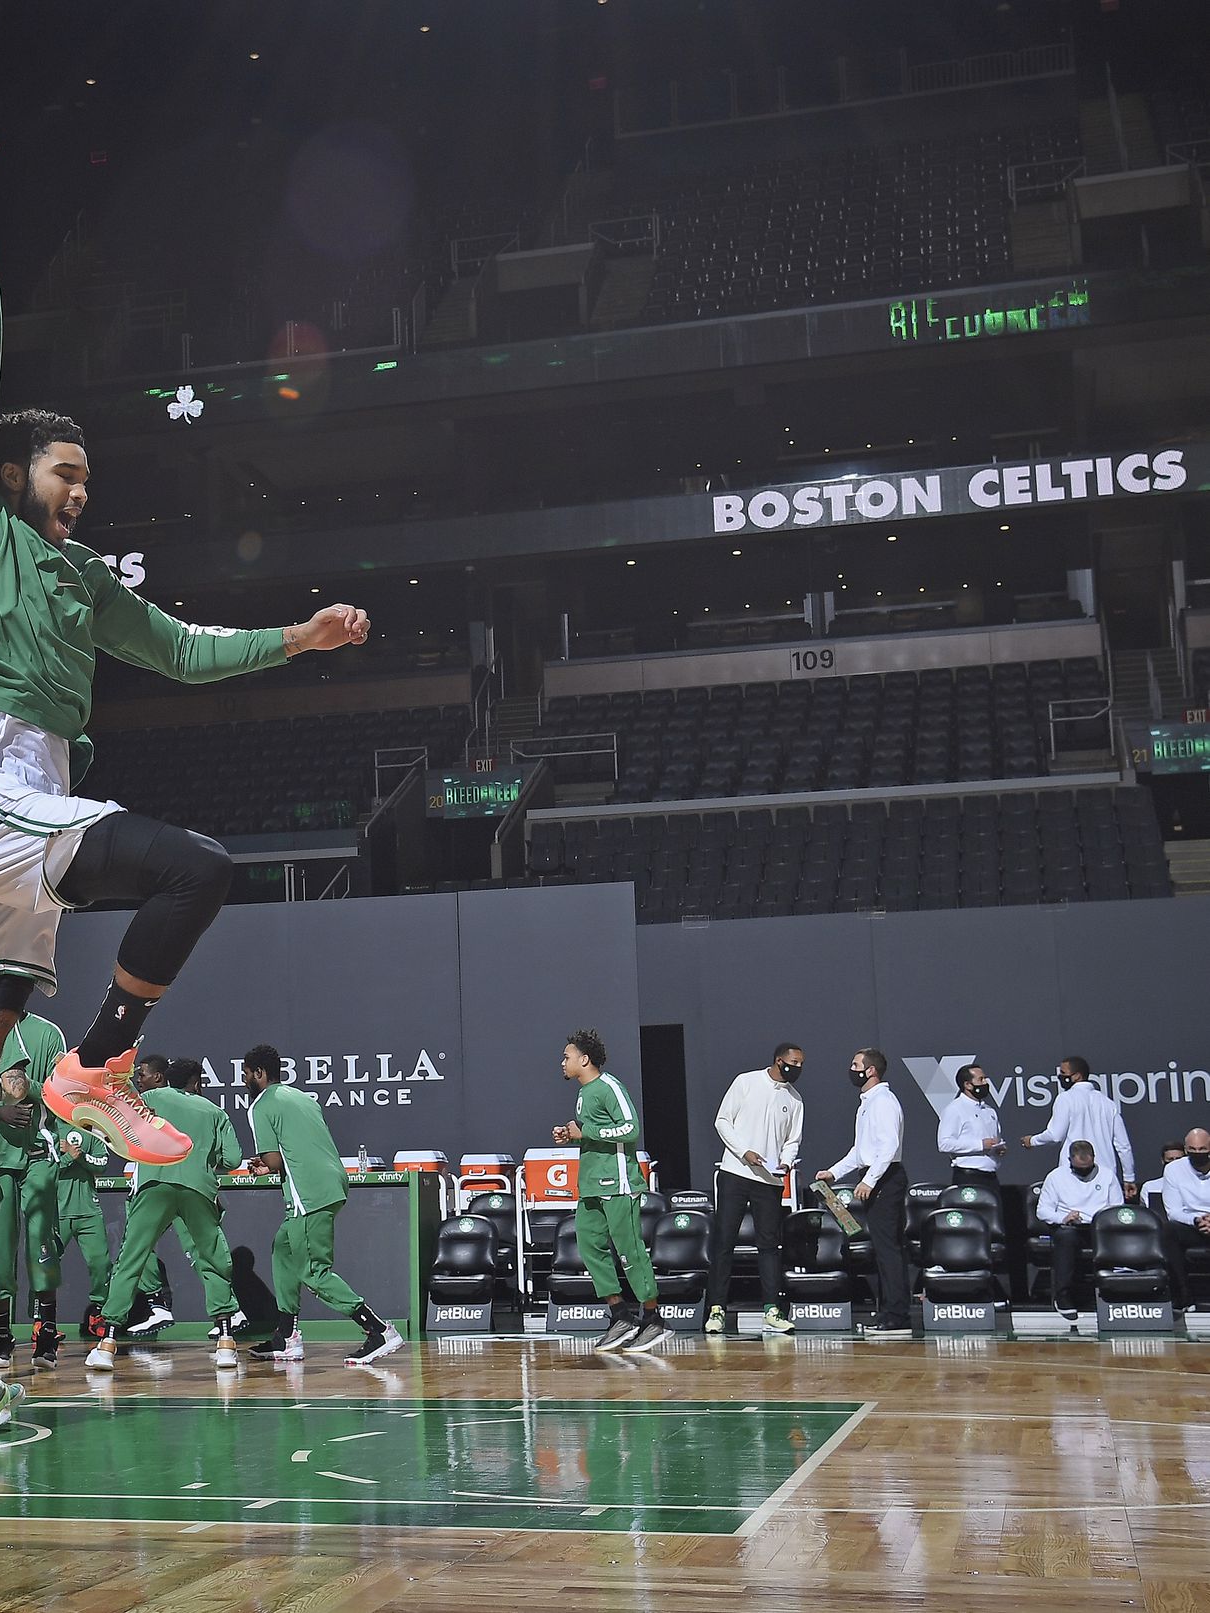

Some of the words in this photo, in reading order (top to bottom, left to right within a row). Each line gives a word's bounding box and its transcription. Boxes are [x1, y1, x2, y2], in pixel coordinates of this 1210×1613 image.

[713, 475, 942, 533] BOSTON
[968, 449, 1187, 507] CELTICS
[792, 648, 834, 673] 109
[1186, 709, 1207, 724] EXIT
[1132, 748, 1148, 763] 21
[475, 759, 493, 773] EXIT
[429, 795, 443, 809] 20
[220, 1088, 413, 1110] INANCE
[94, 1178, 115, 1188] finity
[231, 1175, 257, 1185] xfinity
[377, 1172, 404, 1182] xfinity
[547, 1164, 568, 1187] G
[435, 1306, 483, 1322] jetBlue
[556, 1306, 604, 1322] jetBlue
[657, 1305, 695, 1319] tBlue
[791, 1304, 841, 1320] jetBlue
[933, 1304, 985, 1321] jetBlue
[1108, 1304, 1162, 1321] jetBlue
